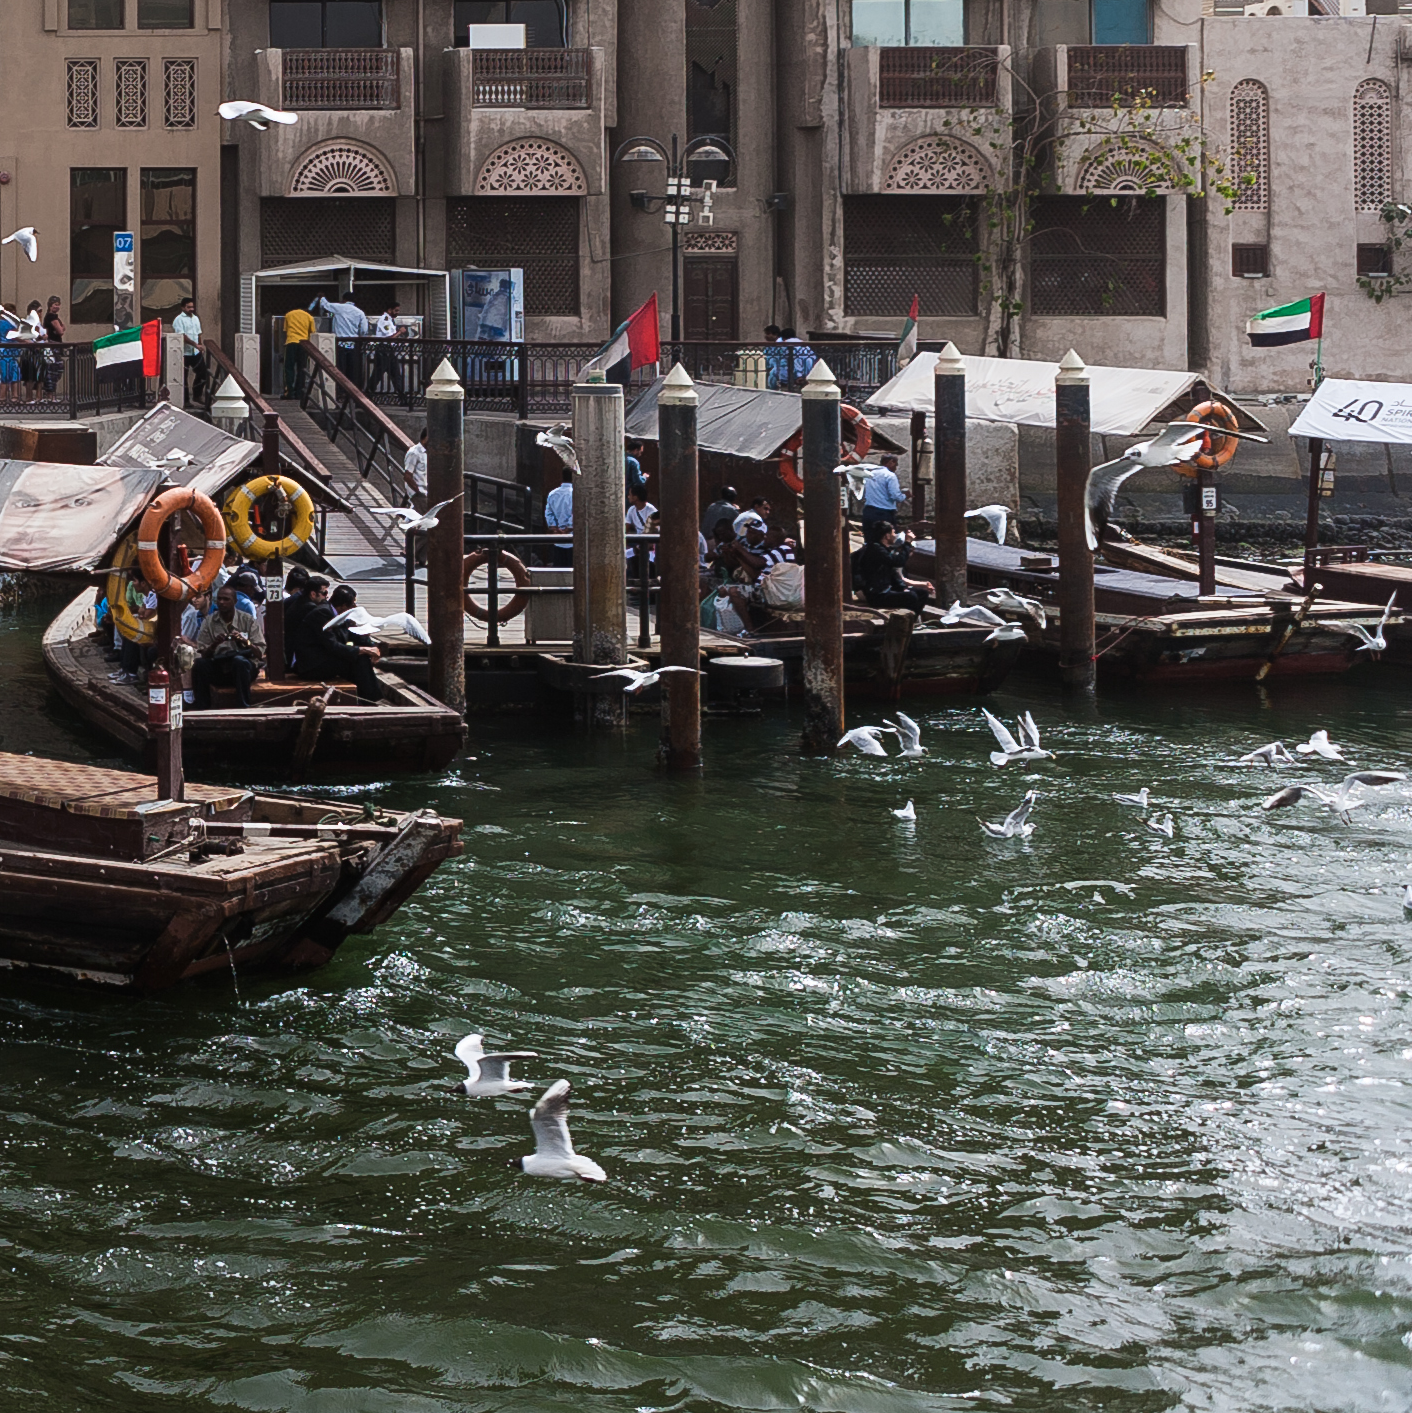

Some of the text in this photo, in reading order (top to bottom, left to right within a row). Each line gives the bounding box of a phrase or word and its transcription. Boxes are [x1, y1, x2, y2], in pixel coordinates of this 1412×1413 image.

[116, 238, 132, 248] 07
[1332, 399, 1384, 423] 40
[269, 589, 280, 600] 73
